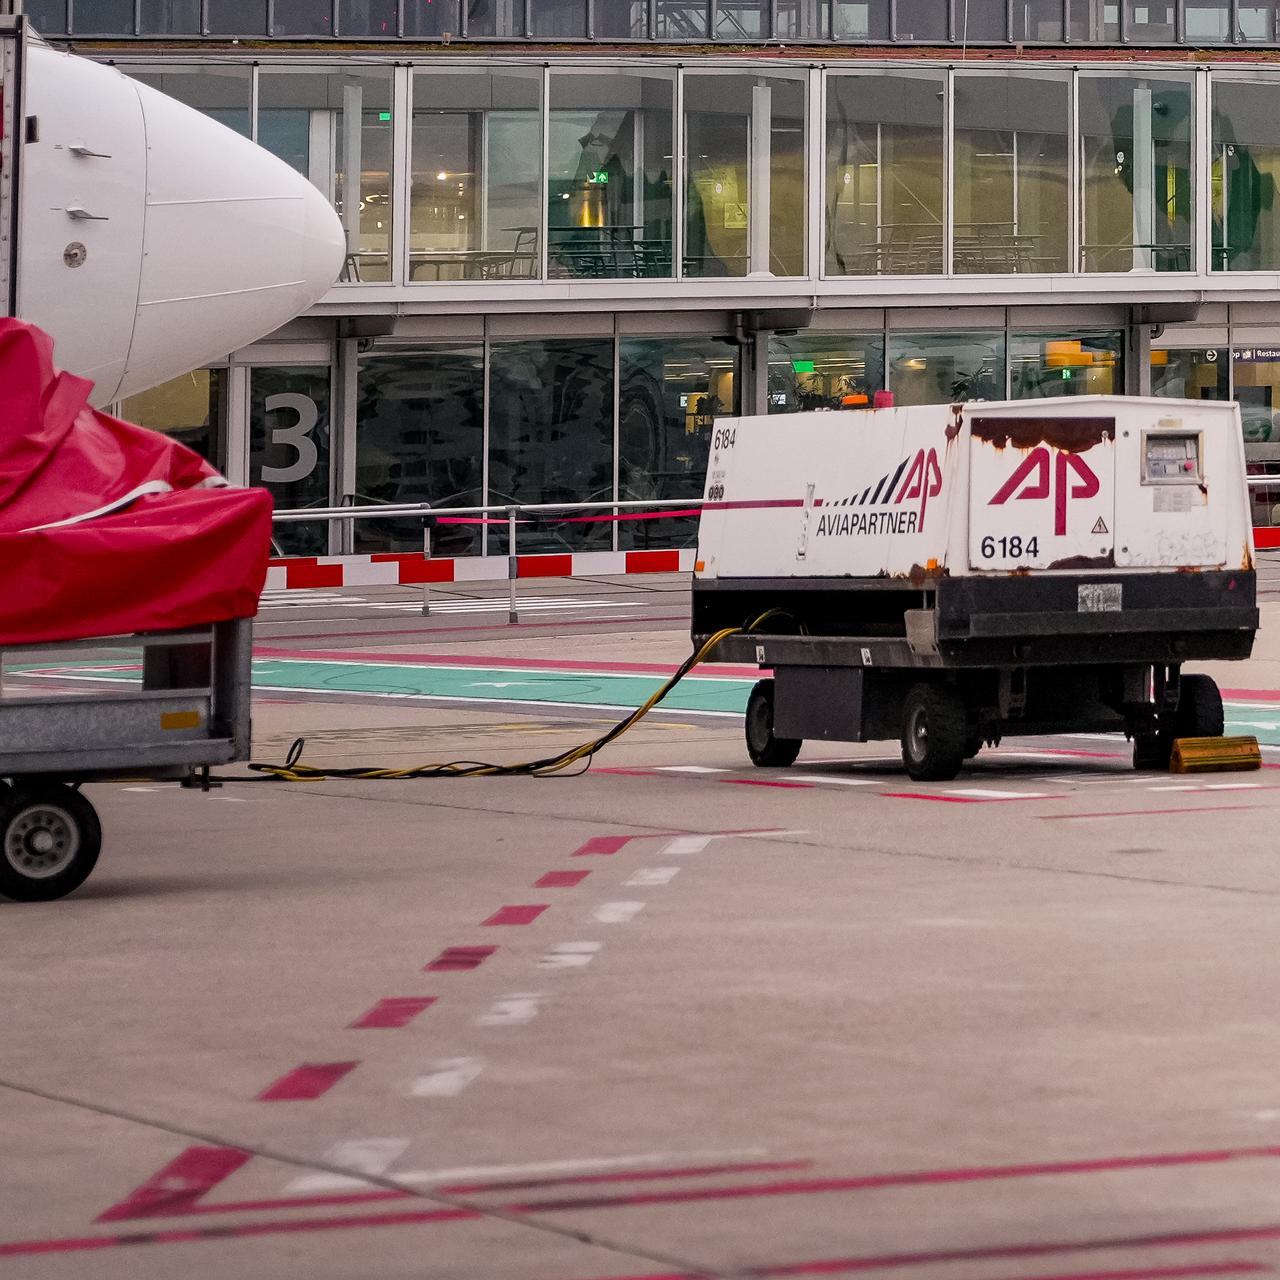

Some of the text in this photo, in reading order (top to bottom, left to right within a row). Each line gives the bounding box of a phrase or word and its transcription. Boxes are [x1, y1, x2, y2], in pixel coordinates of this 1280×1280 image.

[261, 393, 318, 482] 3
[714, 428, 737, 450] 6184
[816, 511, 918, 537] AVIAPARTNER
[980, 535, 1040, 559] 6184
